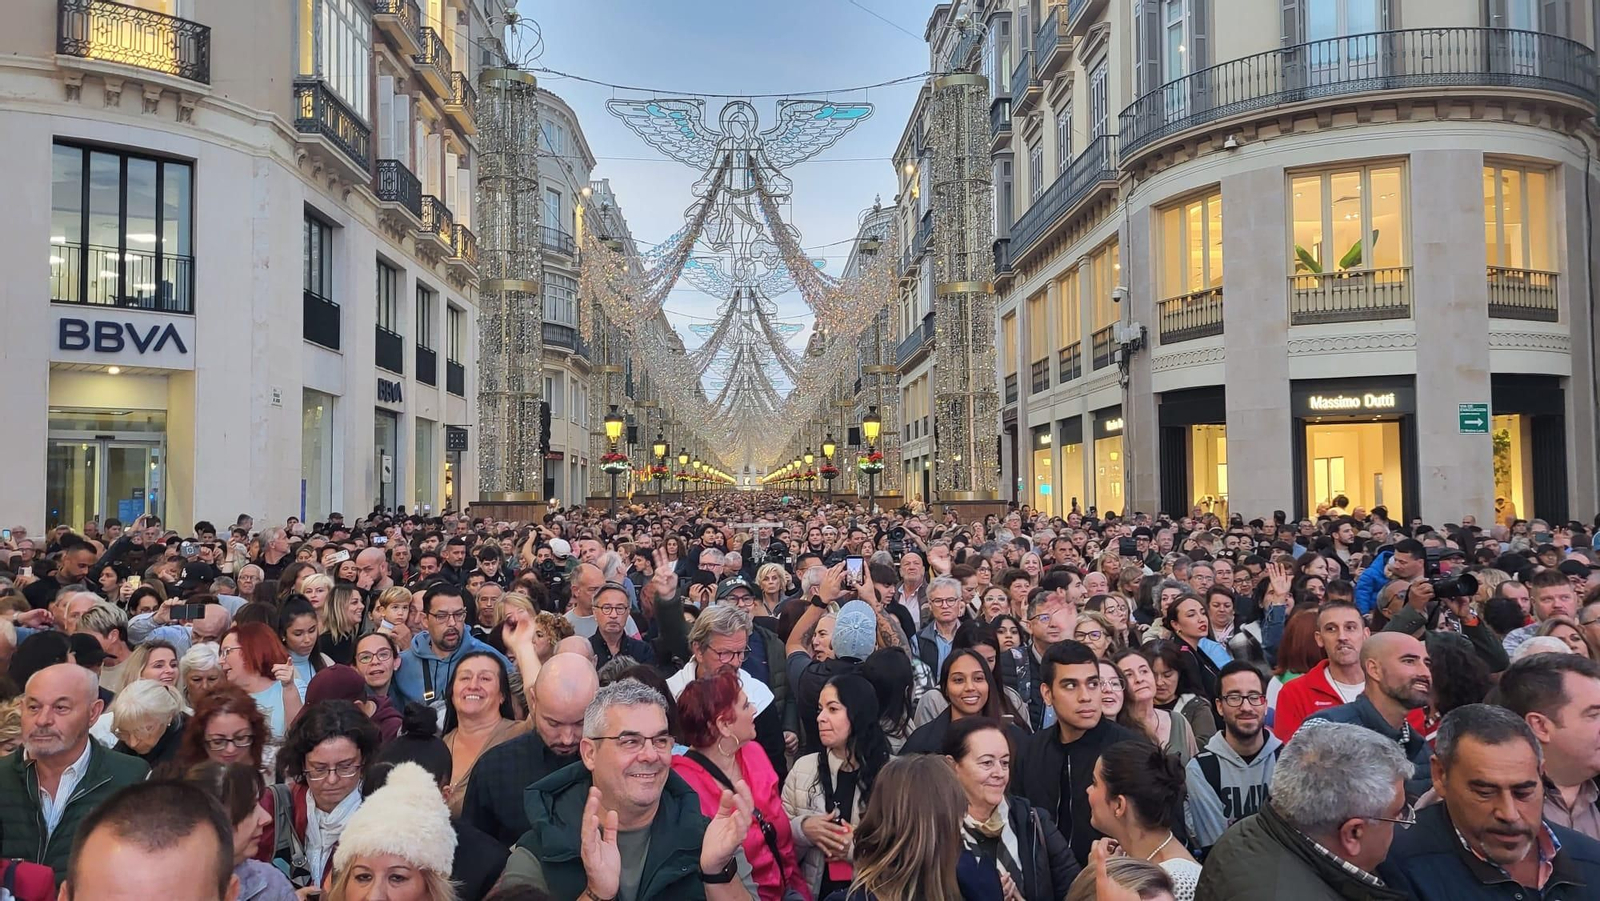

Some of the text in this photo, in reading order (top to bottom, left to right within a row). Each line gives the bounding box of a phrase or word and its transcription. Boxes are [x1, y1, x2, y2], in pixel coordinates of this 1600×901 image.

[59, 317, 188, 354] BBVA
[377, 377, 403, 403] BBVA
[1310, 392, 1396, 410] Massimo Dutti
